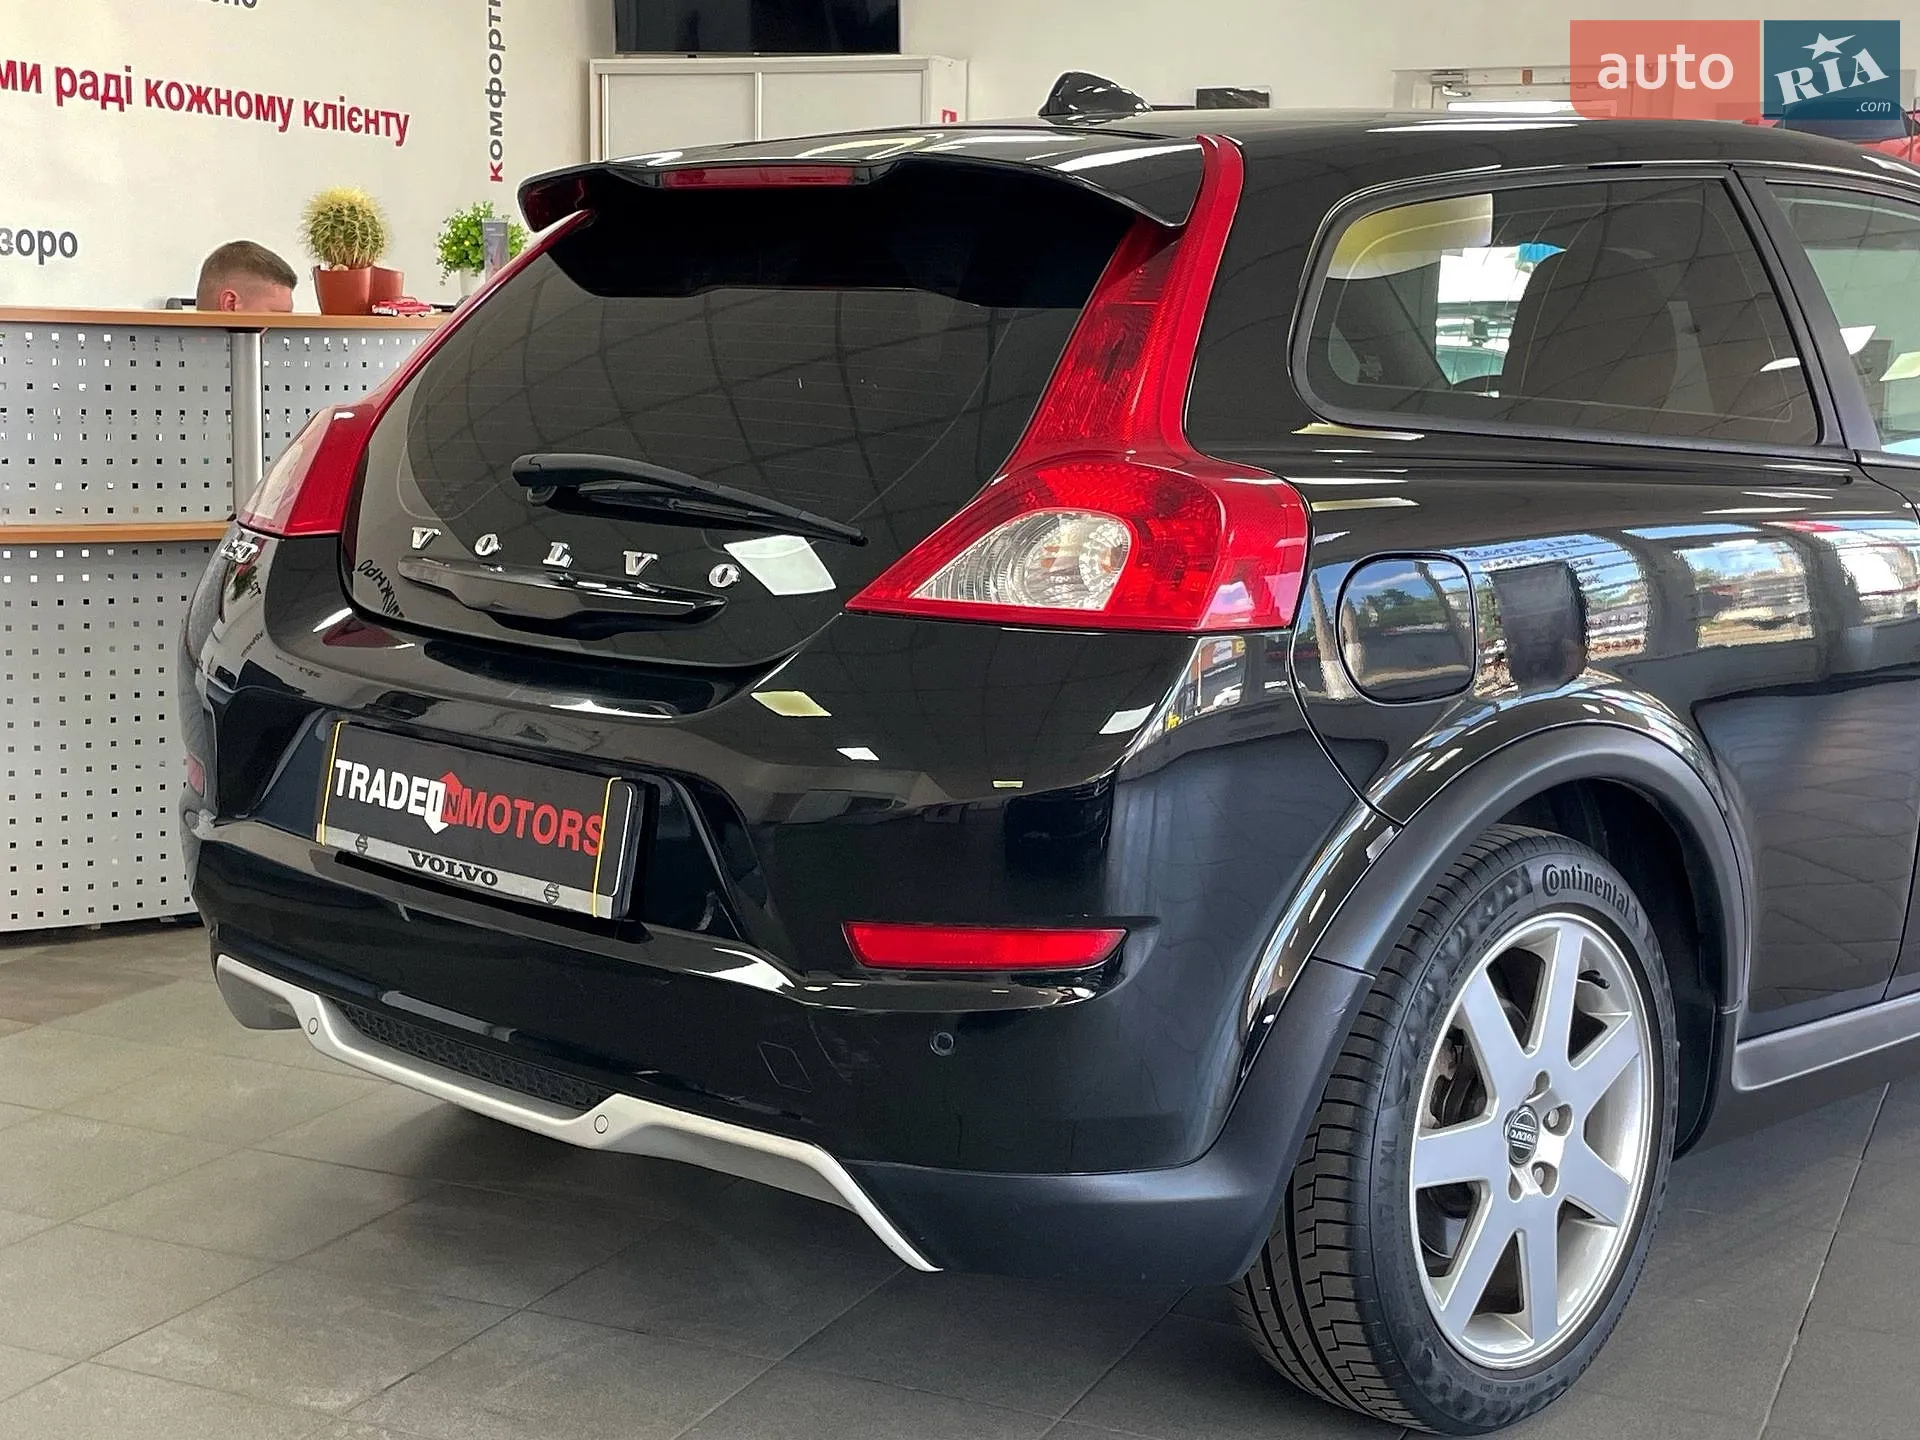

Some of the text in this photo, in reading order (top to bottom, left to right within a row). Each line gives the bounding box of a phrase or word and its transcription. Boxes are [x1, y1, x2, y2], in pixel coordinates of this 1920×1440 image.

[55, 65, 133, 113] раді
[144, 78, 294, 133] кожному
[303, 95, 410, 147] клієнту
[411, 526, 741, 588] VOLVO
[407, 849, 498, 886] VOLVO
[1542, 863, 1630, 917] Continental
